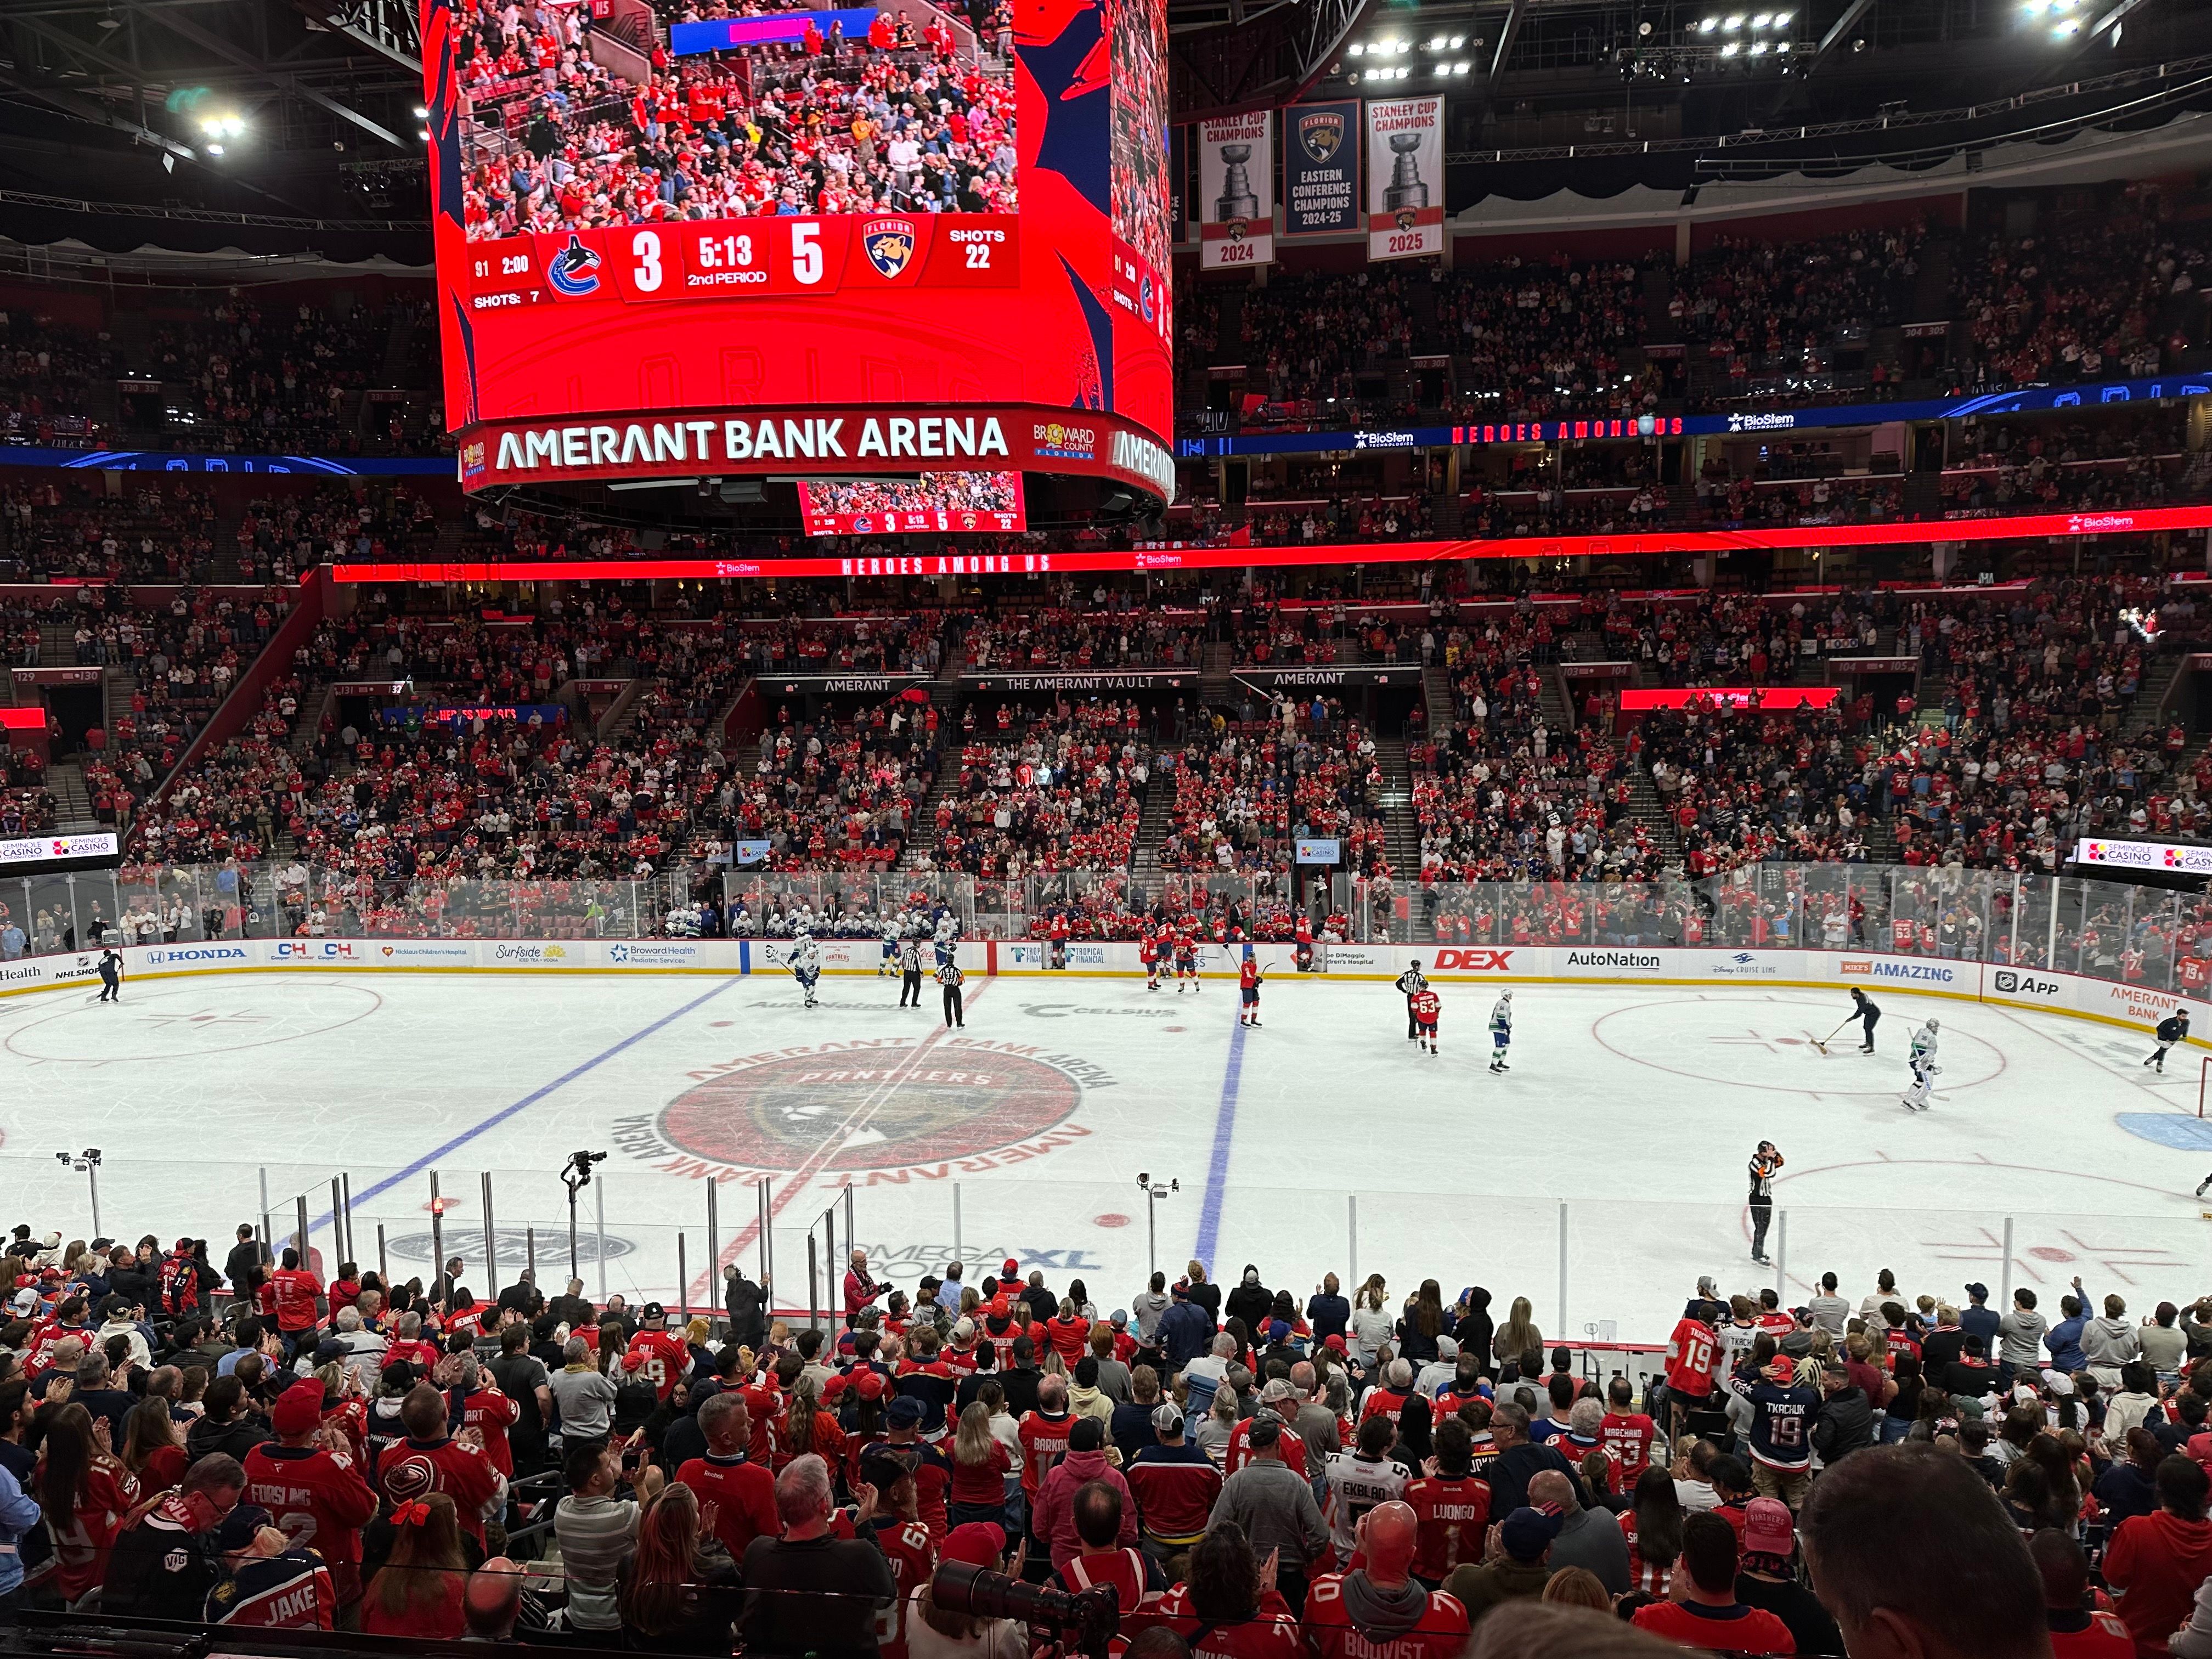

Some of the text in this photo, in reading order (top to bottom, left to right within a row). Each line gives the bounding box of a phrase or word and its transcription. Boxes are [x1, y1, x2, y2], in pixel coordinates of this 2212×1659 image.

[1372, 102, 1438, 119] STANLEY CUP
[1204, 112, 1266, 129] STANLEY CUP
[1305, 117, 1339, 127] FLORIDA
[1375, 116, 1435, 132] CHAMPIONS
[1207, 126, 1265, 143] CHAMPIONS
[1301, 169, 1342, 183] EASTERN
[1293, 182, 1351, 198] CONFERENCE
[1294, 196, 1349, 211] CHAMPIONS
[1302, 211, 1341, 225] 2024-25
[867, 223, 910, 235] FLORIDA
[950, 229, 1006, 243] SHOTS
[1389, 233, 1423, 253] 2025
[699, 235, 753, 268] 5:13
[792, 222, 823, 285] 5
[966, 244, 990, 269] 22
[1221, 244, 1254, 262] 2024
[475, 255, 528, 277] 91 2:00
[633, 230, 662, 292] 3
[687, 271, 767, 286] 2nd PERIOD
[474, 291, 539, 308] SHOTS: 7
[1905, 327, 1945, 337] 304 305
[1432, 359, 1445, 368] 303
[1744, 413, 1794, 426] BioStem
[1034, 424, 1094, 444] BROWARD
[1452, 417, 1682, 444] HEROES AMONG US
[496, 416, 1009, 470] AMERANT BANK ARENA
[1369, 432, 1413, 444] BioStem
[1037, 450, 1092, 459] FLORIDA
[1064, 443, 1093, 452] COUNTY
[884, 514, 895, 532] 3
[908, 515, 924, 524] 5:13
[937, 512, 948, 531] 5
[1001, 519, 1012, 529] 22
[2084, 516, 2134, 527] BioStem
[842, 554, 1050, 575] HEROES AMONG US
[1147, 555, 1181, 563] BioStem
[727, 563, 760, 572] BioStem
[1612, 667, 1627, 675] 104
[1839, 662, 1907, 671] 104 105
[825, 680, 890, 692] AMERANT
[1006, 676, 1153, 690] THE AMERANT VAULT
[1274, 673, 1345, 685] AMERANT
[388, 685, 402, 693] 132
[1897, 779, 1909, 788] 72
[2, 842, 41, 850] SEMINOLE
[71, 837, 108, 845] SEMINOLE
[71, 843, 109, 853] CASINO
[3, 847, 42, 856] CASINO
[2108, 851, 2151, 861] CASINO
[2109, 844, 2152, 854] SEMINOLE
[167, 948, 246, 962] HONDA
[278, 943, 306, 956] CH
[325, 943, 351, 956] CH
[496, 944, 540, 959] Surfside
[631, 946, 696, 956] Broward Health
[1075, 947, 1103, 956] TROPICAL
[1434, 950, 1514, 970] DEX
[1567, 952, 1660, 968] AutoNation
[0, 966, 41, 981] Health
[55, 970, 75, 979] NHL
[1712, 966, 1735, 974] Disney
[1844, 962, 1954, 983] MIKE'S AMAZING
[2186, 967, 2197, 980] 19
[2111, 988, 2179, 1011] AMERANT
[1074, 1008, 1177, 1016] CELSIUS
[1419, 1000, 1436, 1014] 63
[2128, 1006, 2159, 1022] BANK
[686, 1037, 1119, 1090] AMERANT BANK ARENA
[797, 1069, 994, 1086] PANTHERS
[612, 1113, 678, 1160] ARENA
[817, 1123, 1093, 1189] AMERANT
[656, 1154, 780, 1188] BANK
[834, 1244, 1008, 1260] OMEGA
[455, 1312, 482, 1328] BENNETT
[1685, 1339, 1712, 1373] 19
[1766, 1402, 1805, 1415] TKACHUK
[1604, 1427, 1642, 1438] MARCHAND
[1769, 1416, 1801, 1447] 19
[704, 1470, 724, 1481] Reebok
[251, 1483, 311, 1507] FORSLING
[1344, 1481, 1386, 1501] EKBLAD
[1432, 1504, 1476, 1520] LUONGO
[1751, 1514, 1785, 1525] PANTHERS
[1446, 1525, 1460, 1570] 1
